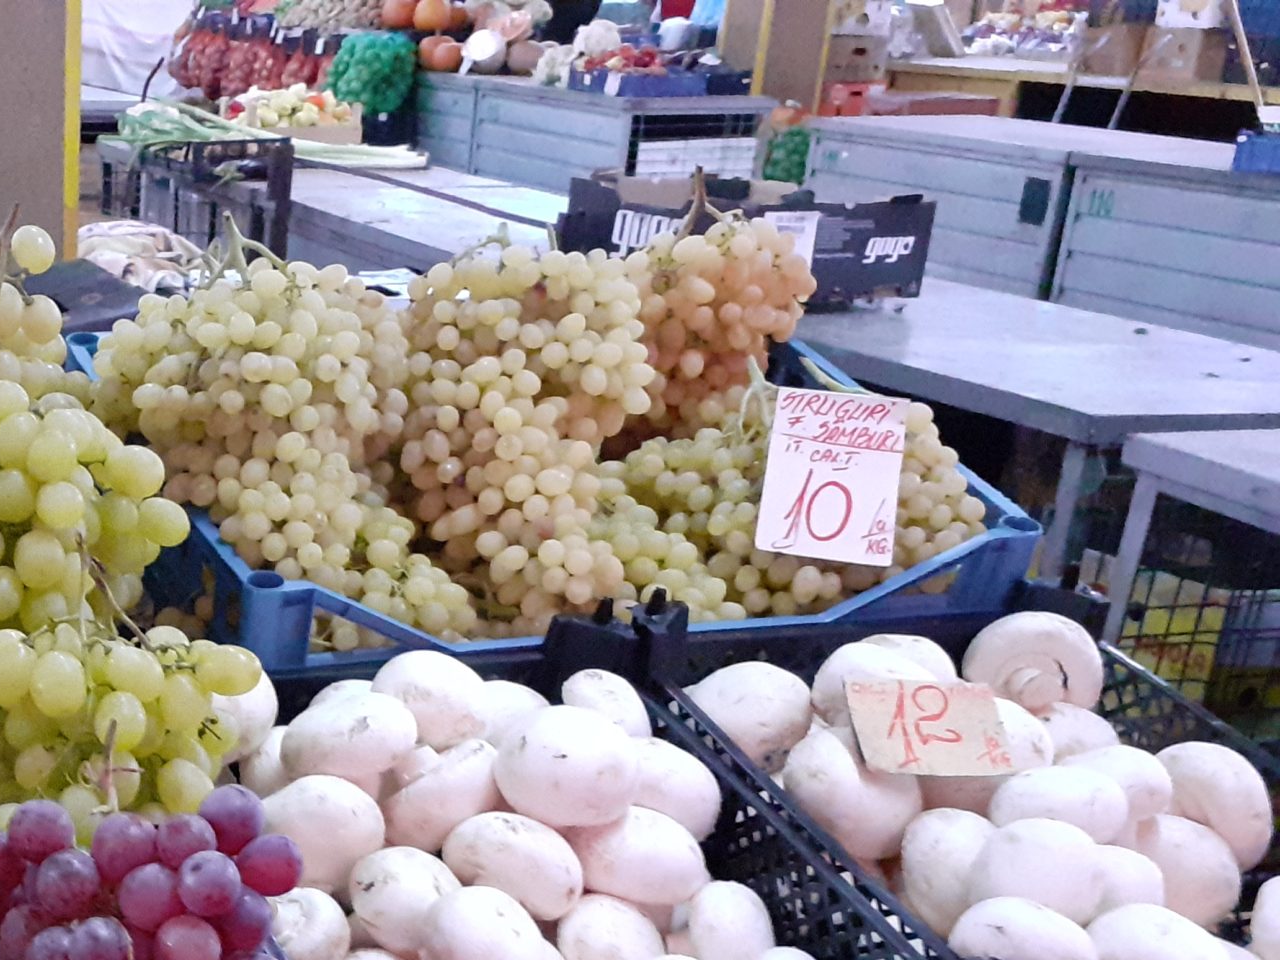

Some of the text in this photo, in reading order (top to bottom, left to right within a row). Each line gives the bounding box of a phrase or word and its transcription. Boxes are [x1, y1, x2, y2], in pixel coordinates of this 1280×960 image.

[780, 392, 894, 424] STRUGURI
[772, 468, 853, 549] 10
[887, 680, 963, 768] 12
